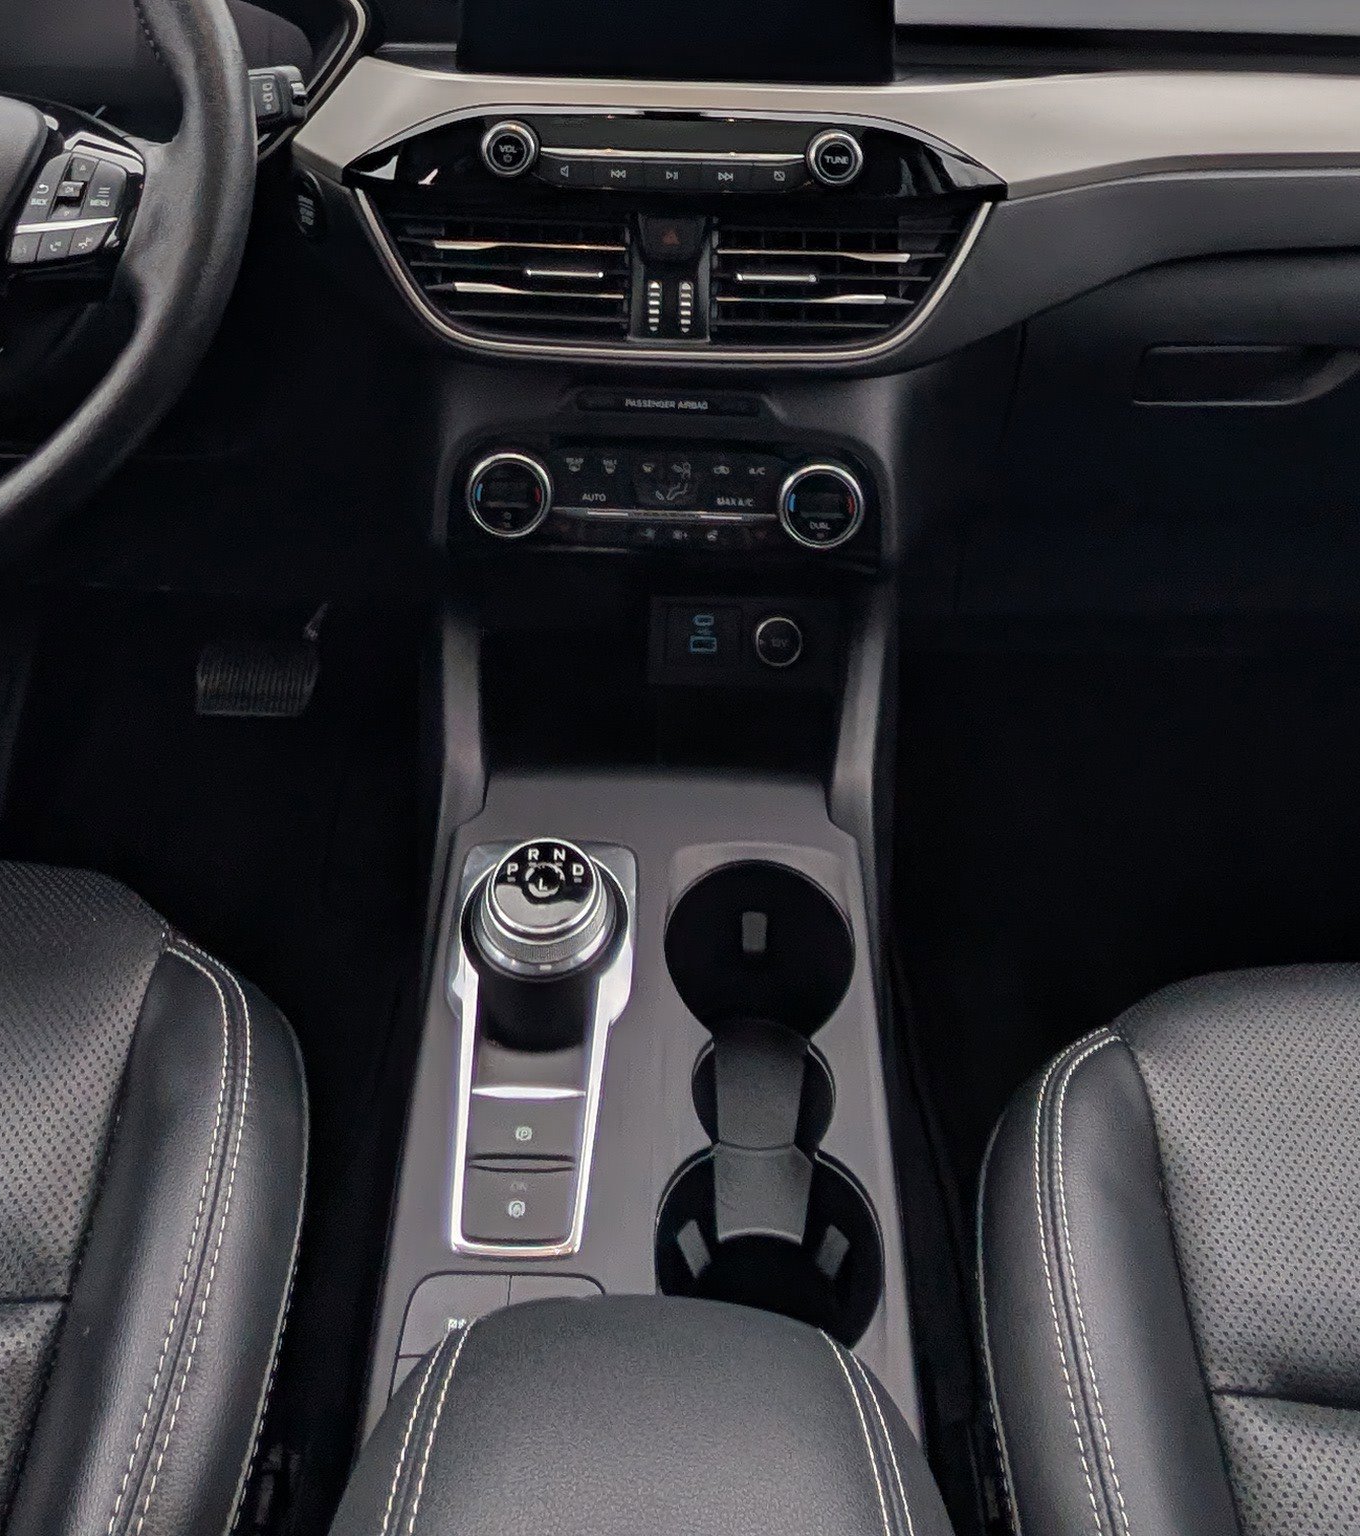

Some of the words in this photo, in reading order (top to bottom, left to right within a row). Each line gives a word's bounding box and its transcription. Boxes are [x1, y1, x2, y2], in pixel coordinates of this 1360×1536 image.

[499, 144, 518, 153] VOL
[823, 154, 849, 165] TUNE
[625, 398, 676, 409] PASSENGER
[677, 400, 709, 410] AIRBAG
[582, 492, 607, 502] AUTO
[527, 848, 540, 861] R
[553, 848, 566, 862] N
[506, 862, 519, 876] P
[571, 863, 585, 877] D
